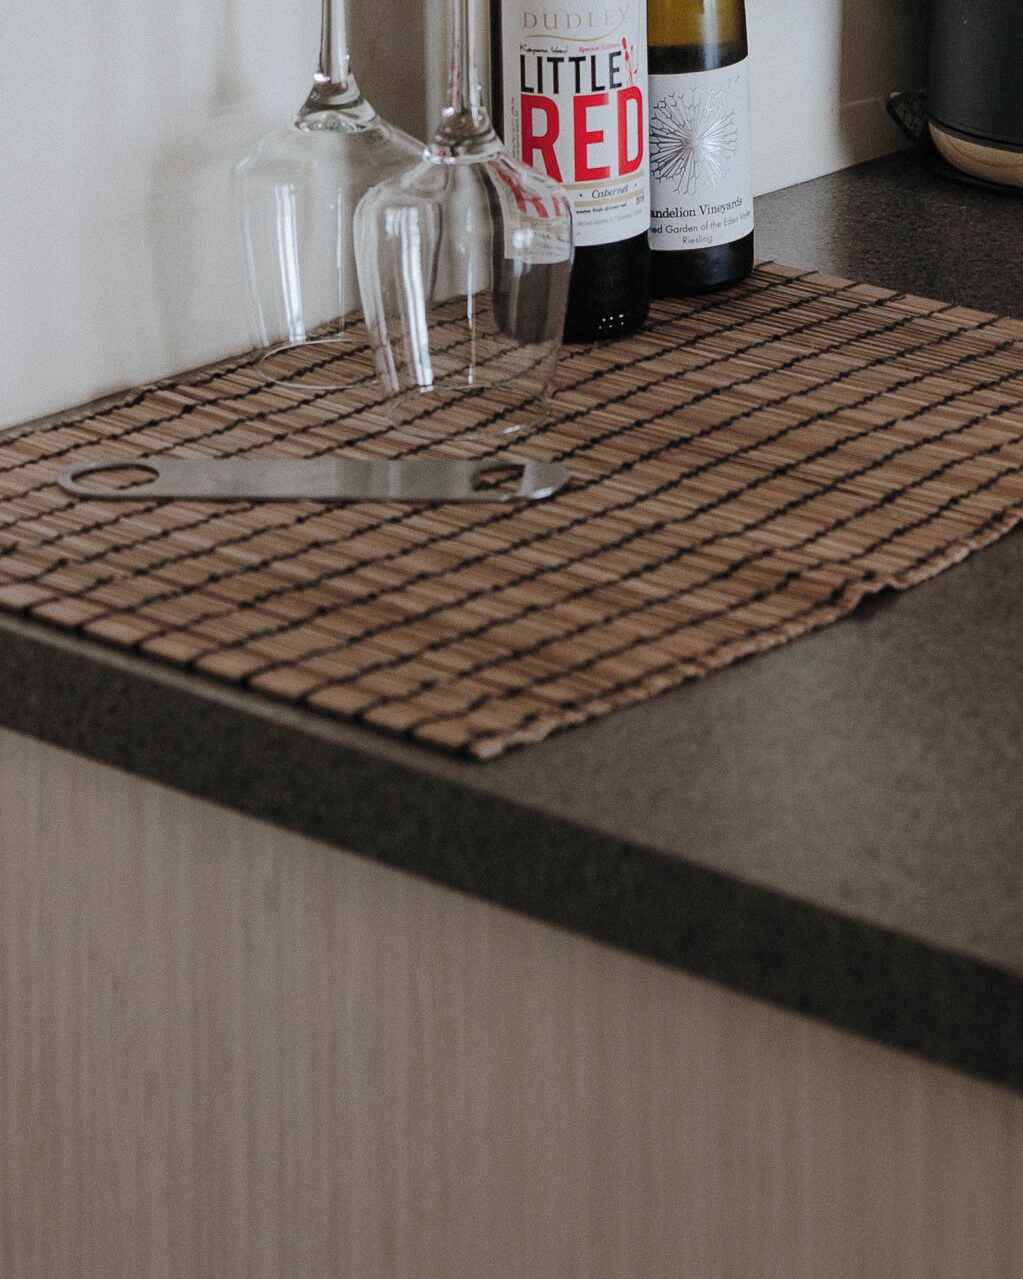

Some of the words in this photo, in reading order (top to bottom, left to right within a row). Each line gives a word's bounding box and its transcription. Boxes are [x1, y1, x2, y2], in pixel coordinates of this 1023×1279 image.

[520, 50, 622, 95] LITTLE
[520, 86, 644, 183] RED
[650, 206, 696, 219] andelion
[699, 196, 742, 215] Vineyards
[665, 223, 698, 234] Garden
[700, 222, 709, 231] of
